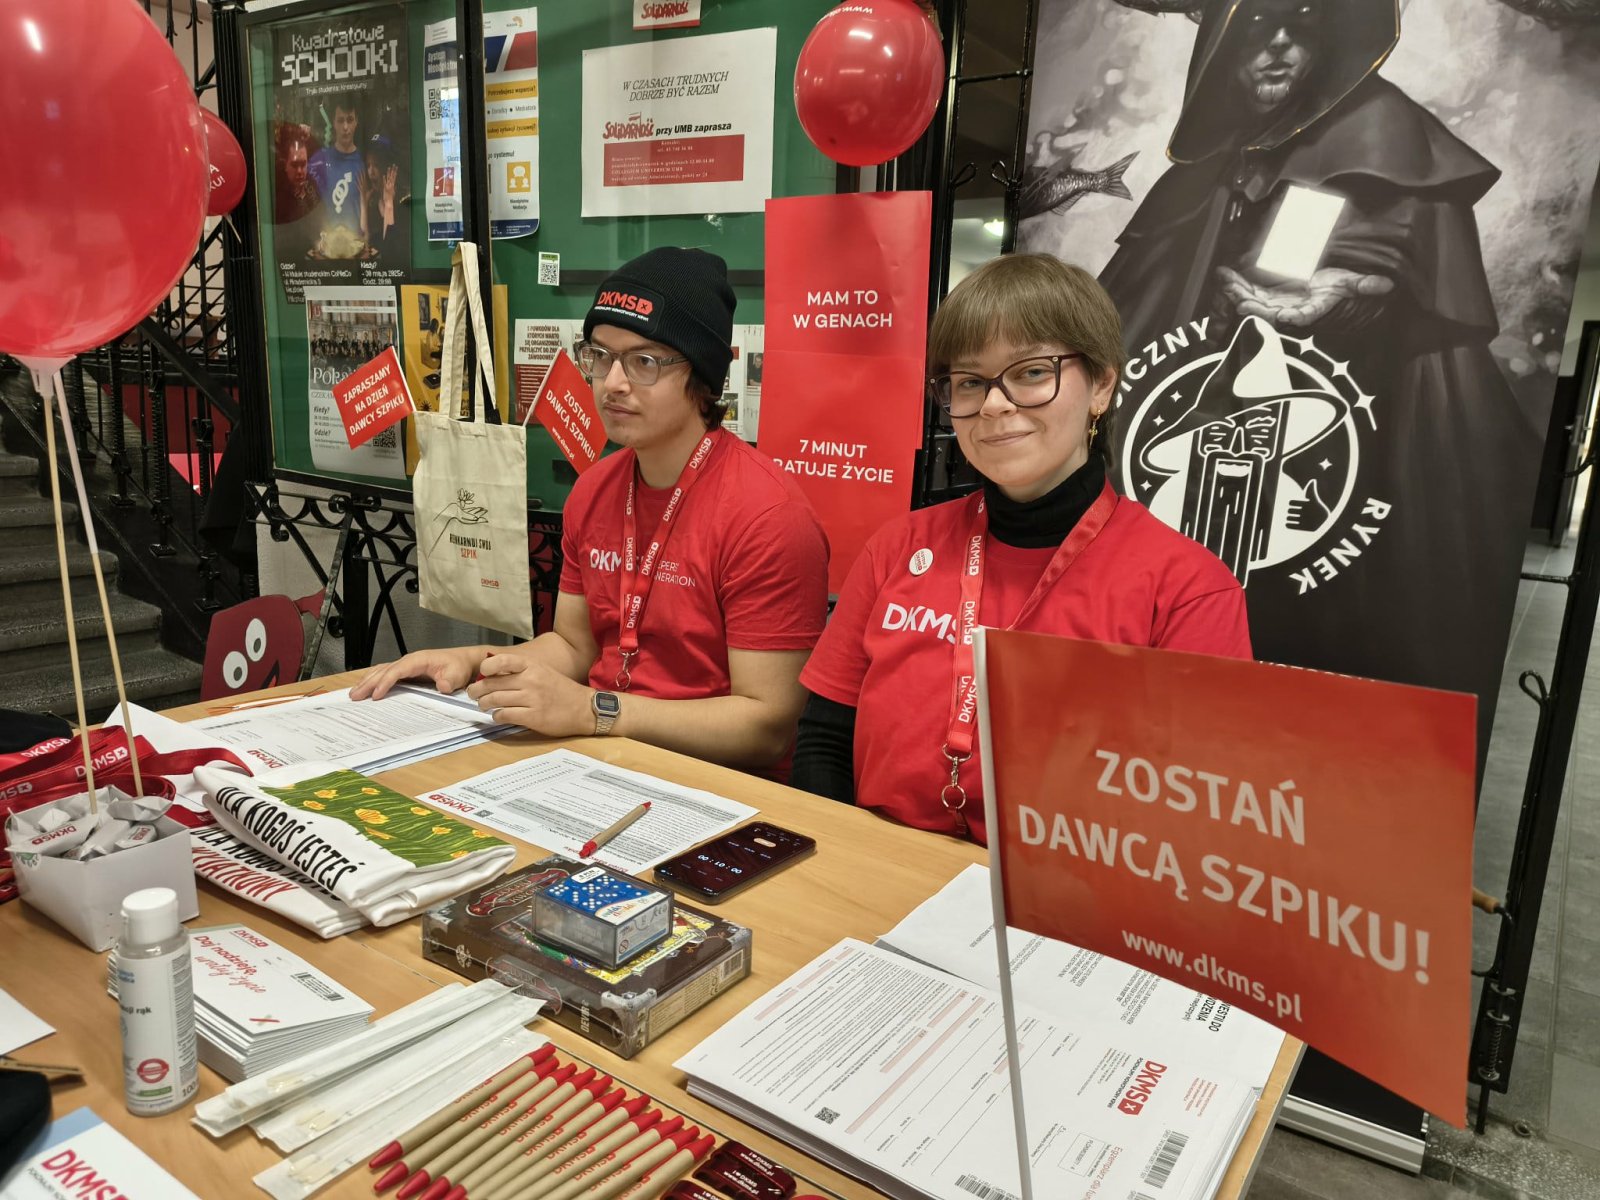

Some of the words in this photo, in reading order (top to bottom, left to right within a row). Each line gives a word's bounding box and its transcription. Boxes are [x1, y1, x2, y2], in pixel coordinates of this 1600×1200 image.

[292, 25, 384, 52] Kwadratowe
[623, 81, 631, 91] W
[632, 77, 675, 91] CZASACH
[677, 71, 729, 87] TRUDNYCH
[629, 88, 664, 101] DOBRZE
[666, 86, 685, 98] BYĆ
[687, 84, 720, 97] RAZEM
[656, 127, 672, 137] przy
[674, 124, 693, 134] UMB
[694, 123, 732, 133] zaprasza
[597, 291, 641, 312] DKMS
[807, 291, 849, 306] MAM
[854, 290, 878, 305] TO
[793, 314, 810, 328] W
[814, 313, 893, 328] GENACH
[1116, 316, 1210, 408] ICZNY
[343, 364, 391, 405] ZAPRASZAMY
[354, 401, 367, 414] NA
[366, 384, 389, 408] DZIEŃ
[349, 413, 376, 436] DAWCY
[375, 393, 405, 418] SZPIKU
[563, 390, 591, 431] ZOSTAŃ
[545, 389, 570, 429] DAWCĄ
[569, 422, 596, 463] SZPIKU!
[689, 439, 711, 469] DKMS
[800, 440, 809, 453] 7
[812, 440, 867, 459] MINUT
[842, 461, 894, 484] ŻYCIE
[663, 489, 681, 522] DKMS
[460, 548, 477, 559] SZPIK
[589, 548, 622, 572] DKM
[626, 537, 634, 568] DKMS
[641, 546, 657, 576] DKMS
[969, 535, 982, 570] DKMS
[1289, 497, 1392, 595] RYNEK
[655, 571, 696, 587] NERATION
[626, 598, 641, 629] DKMS
[20, 739, 68, 758] DKMS
[434, 794, 478, 813] DKMS
[1094, 749, 1306, 846] ZOSTAŃ
[39, 825, 77, 844] DKMS
[216, 786, 255, 819] DLA
[243, 801, 313, 854] KOGOŚ
[288, 834, 366, 892] JESTEŚ
[1018, 804, 1190, 901] DAWCĄ
[1201, 855, 1431, 986] SZPIKU!
[194, 935, 216, 949] Daj
[211, 943, 258, 976] nadzieję,
[1121, 930, 1304, 1023] www.dkms.pl
[1208, 1020, 1220, 1032] DO
[1122, 1060, 1168, 1105] DKMS
[41, 1149, 117, 1200] DKMS
